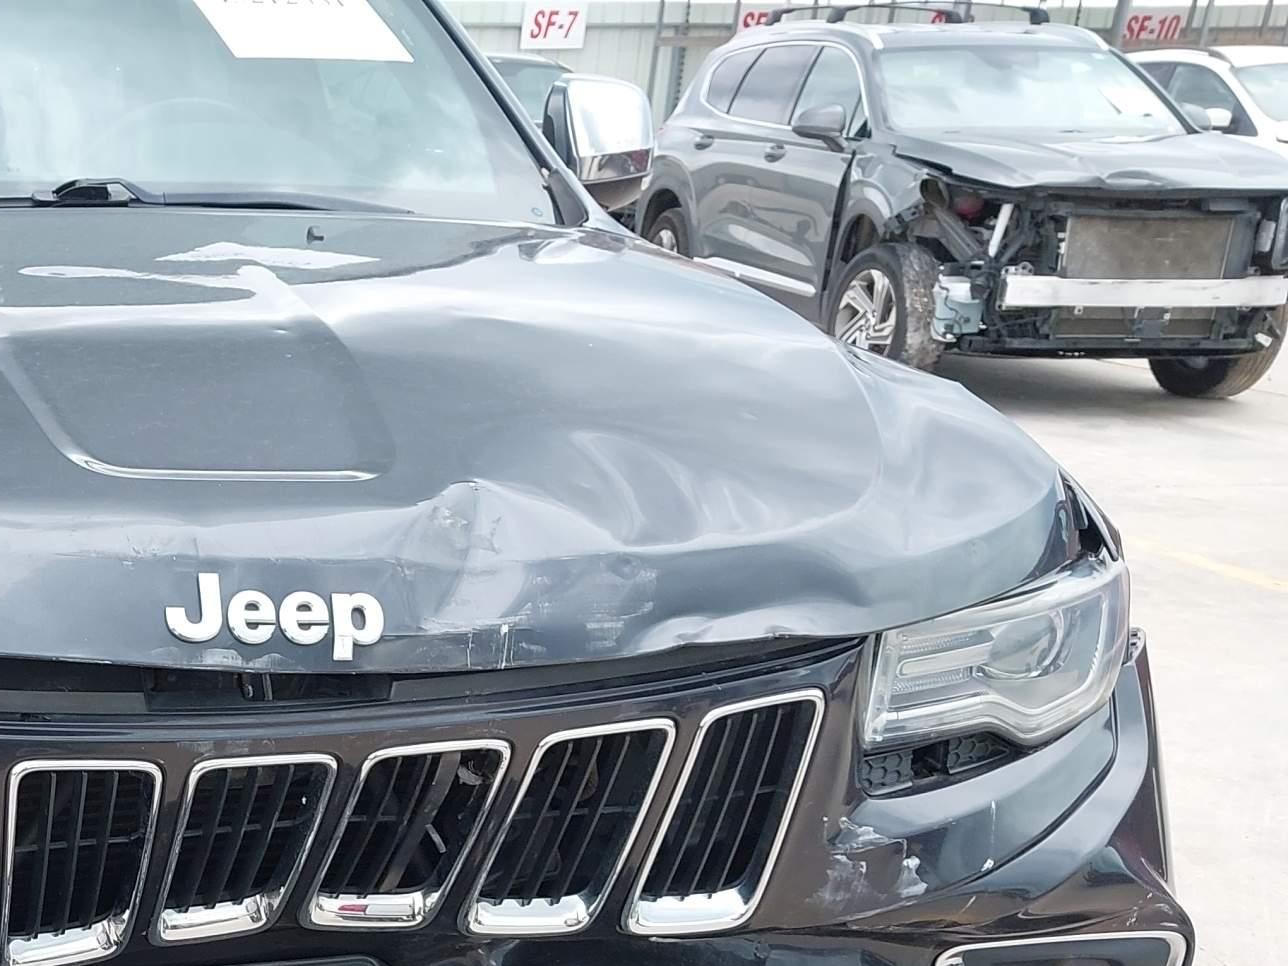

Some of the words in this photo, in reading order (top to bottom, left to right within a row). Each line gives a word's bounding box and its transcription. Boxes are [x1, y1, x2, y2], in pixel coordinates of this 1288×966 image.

[530, 9, 580, 39] SF-7
[1123, 15, 1181, 40] SF-10
[165, 572, 385, 661] Jeep
